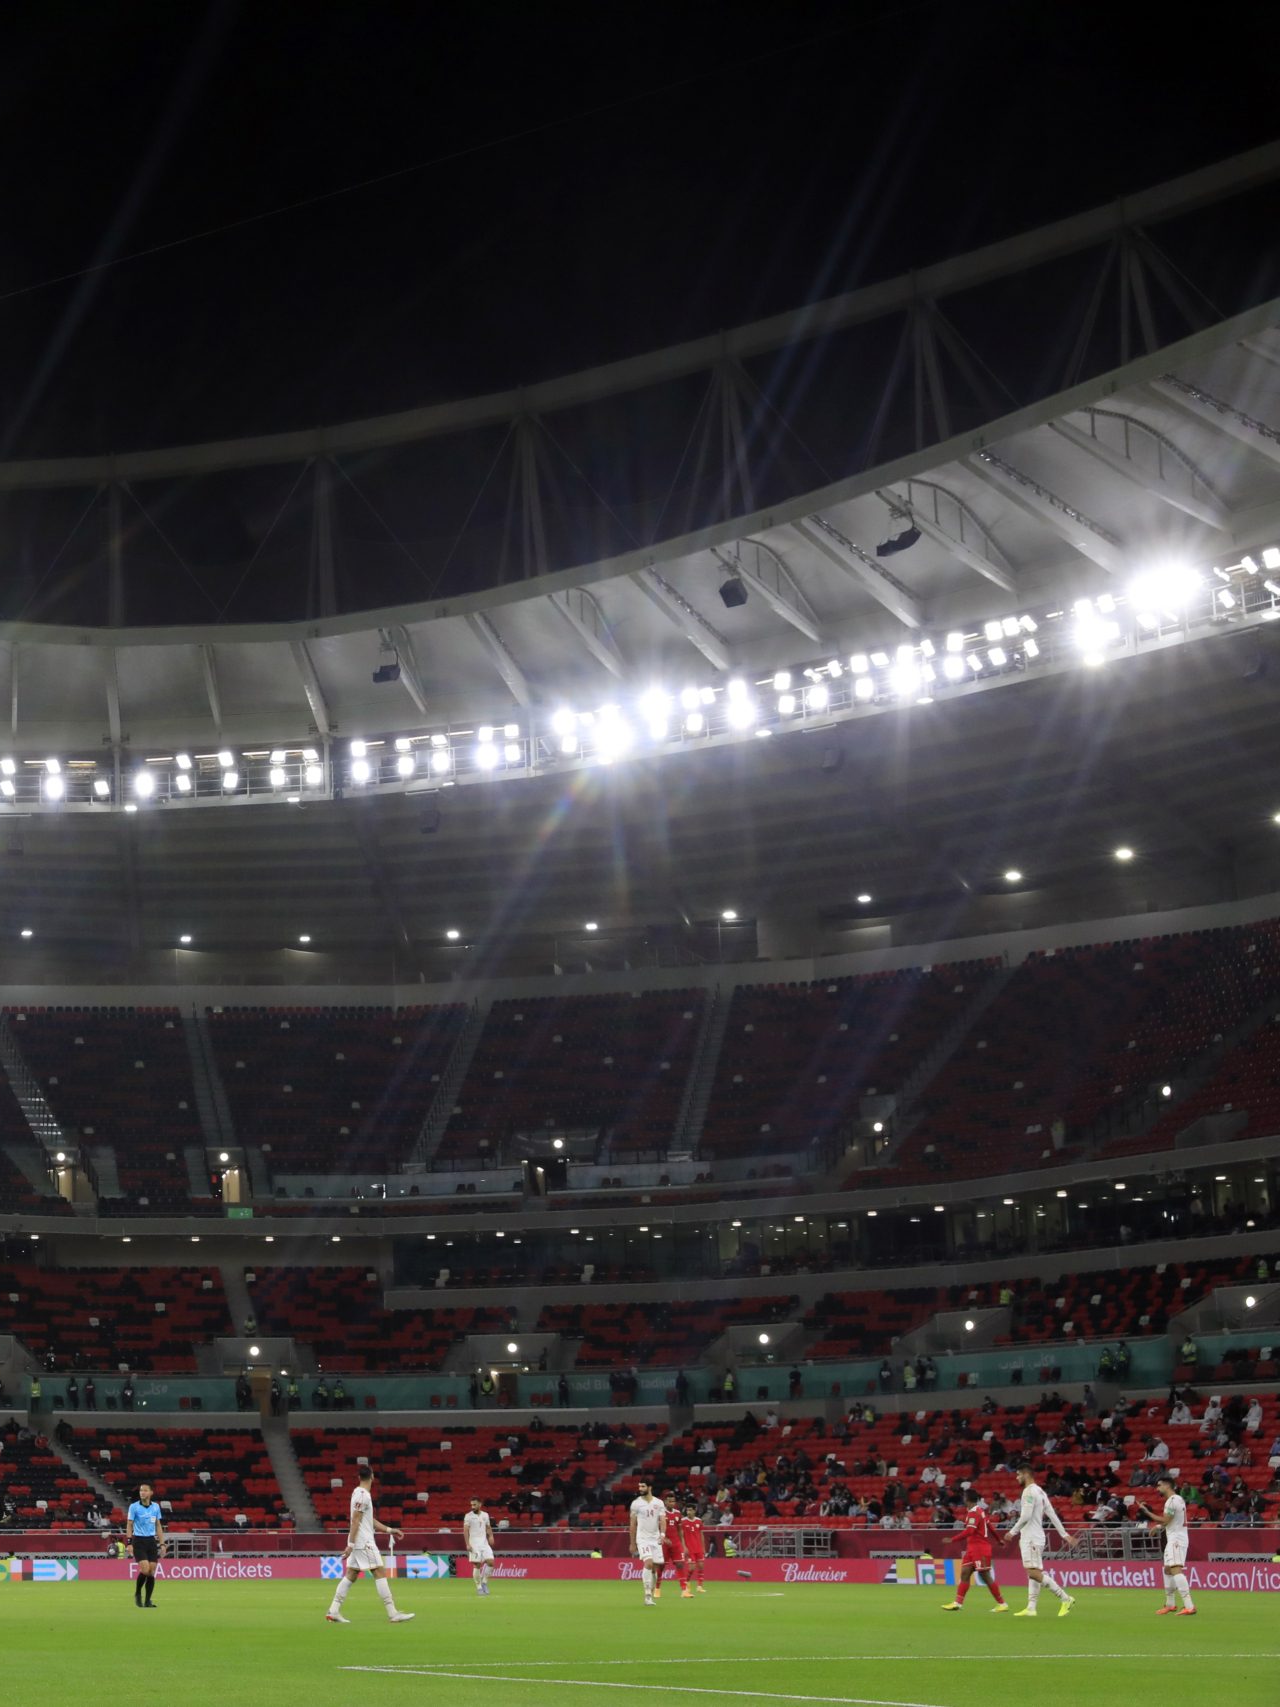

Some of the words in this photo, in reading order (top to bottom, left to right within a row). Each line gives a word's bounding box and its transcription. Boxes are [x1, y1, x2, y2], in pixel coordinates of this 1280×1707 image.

[129, 1561, 272, 1579] FA.com/tickets
[781, 1562, 847, 1582] Budweiser
[1059, 1571, 1097, 1587] your
[1101, 1566, 1156, 1586] ticket!
